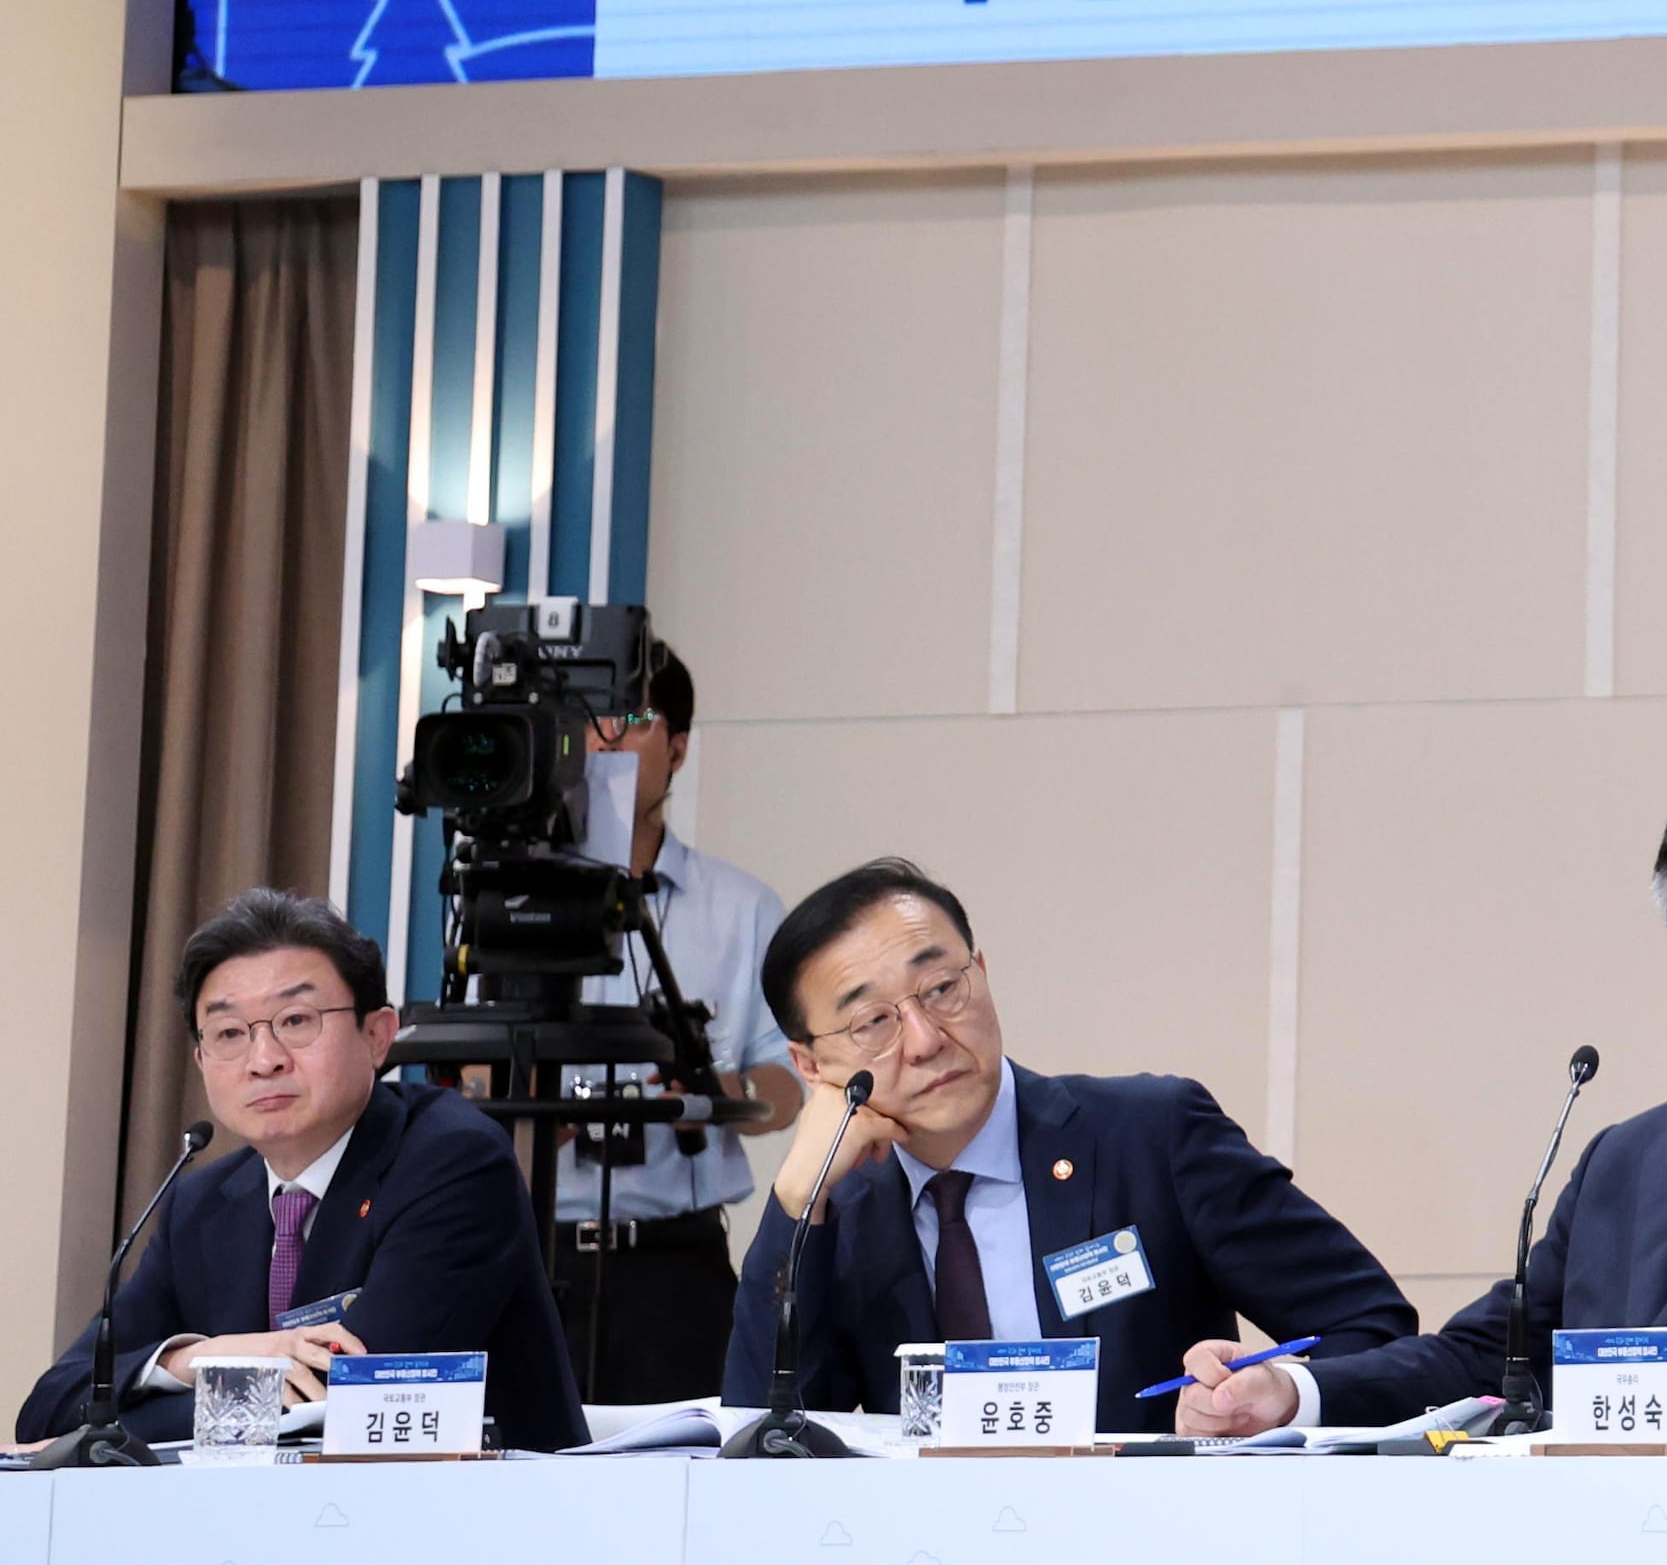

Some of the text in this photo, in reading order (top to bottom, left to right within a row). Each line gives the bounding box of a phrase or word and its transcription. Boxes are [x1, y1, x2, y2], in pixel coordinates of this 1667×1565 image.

[536, 644, 583, 660] ONY
[1077, 1271, 1132, 1304] 김윤덕
[366, 1410, 440, 1444] 김윤덕
[981, 1401, 1053, 1435] 윤호중
[1592, 1394, 1663, 1432] 한성숙
